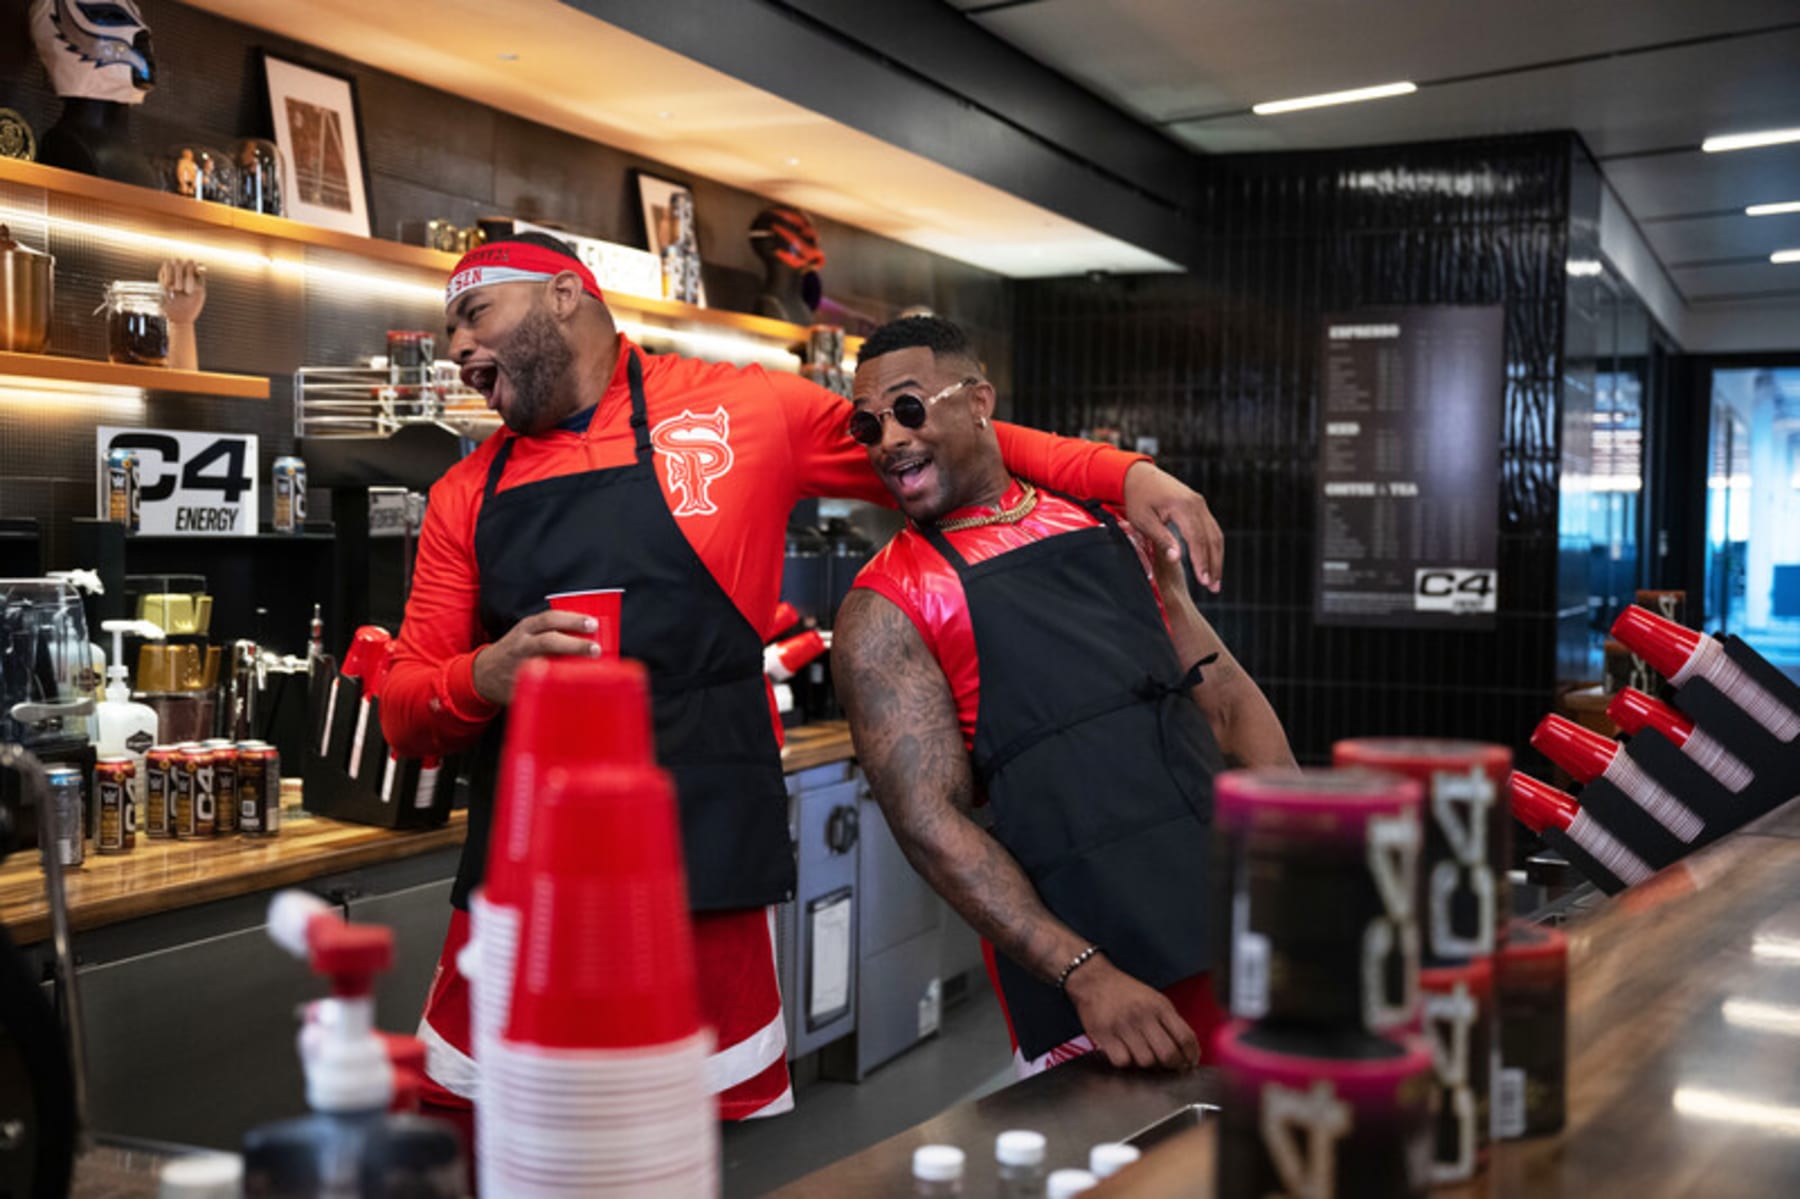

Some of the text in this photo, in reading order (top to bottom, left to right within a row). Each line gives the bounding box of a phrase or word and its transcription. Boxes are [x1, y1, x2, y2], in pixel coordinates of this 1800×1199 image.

[109, 432, 252, 502] C4
[175, 507, 239, 531] ENERGY
[1420, 573, 1495, 597] C4
[196, 765, 215, 821] C4
[1430, 764, 1497, 958] C4
[1362, 804, 1421, 1034] C4
